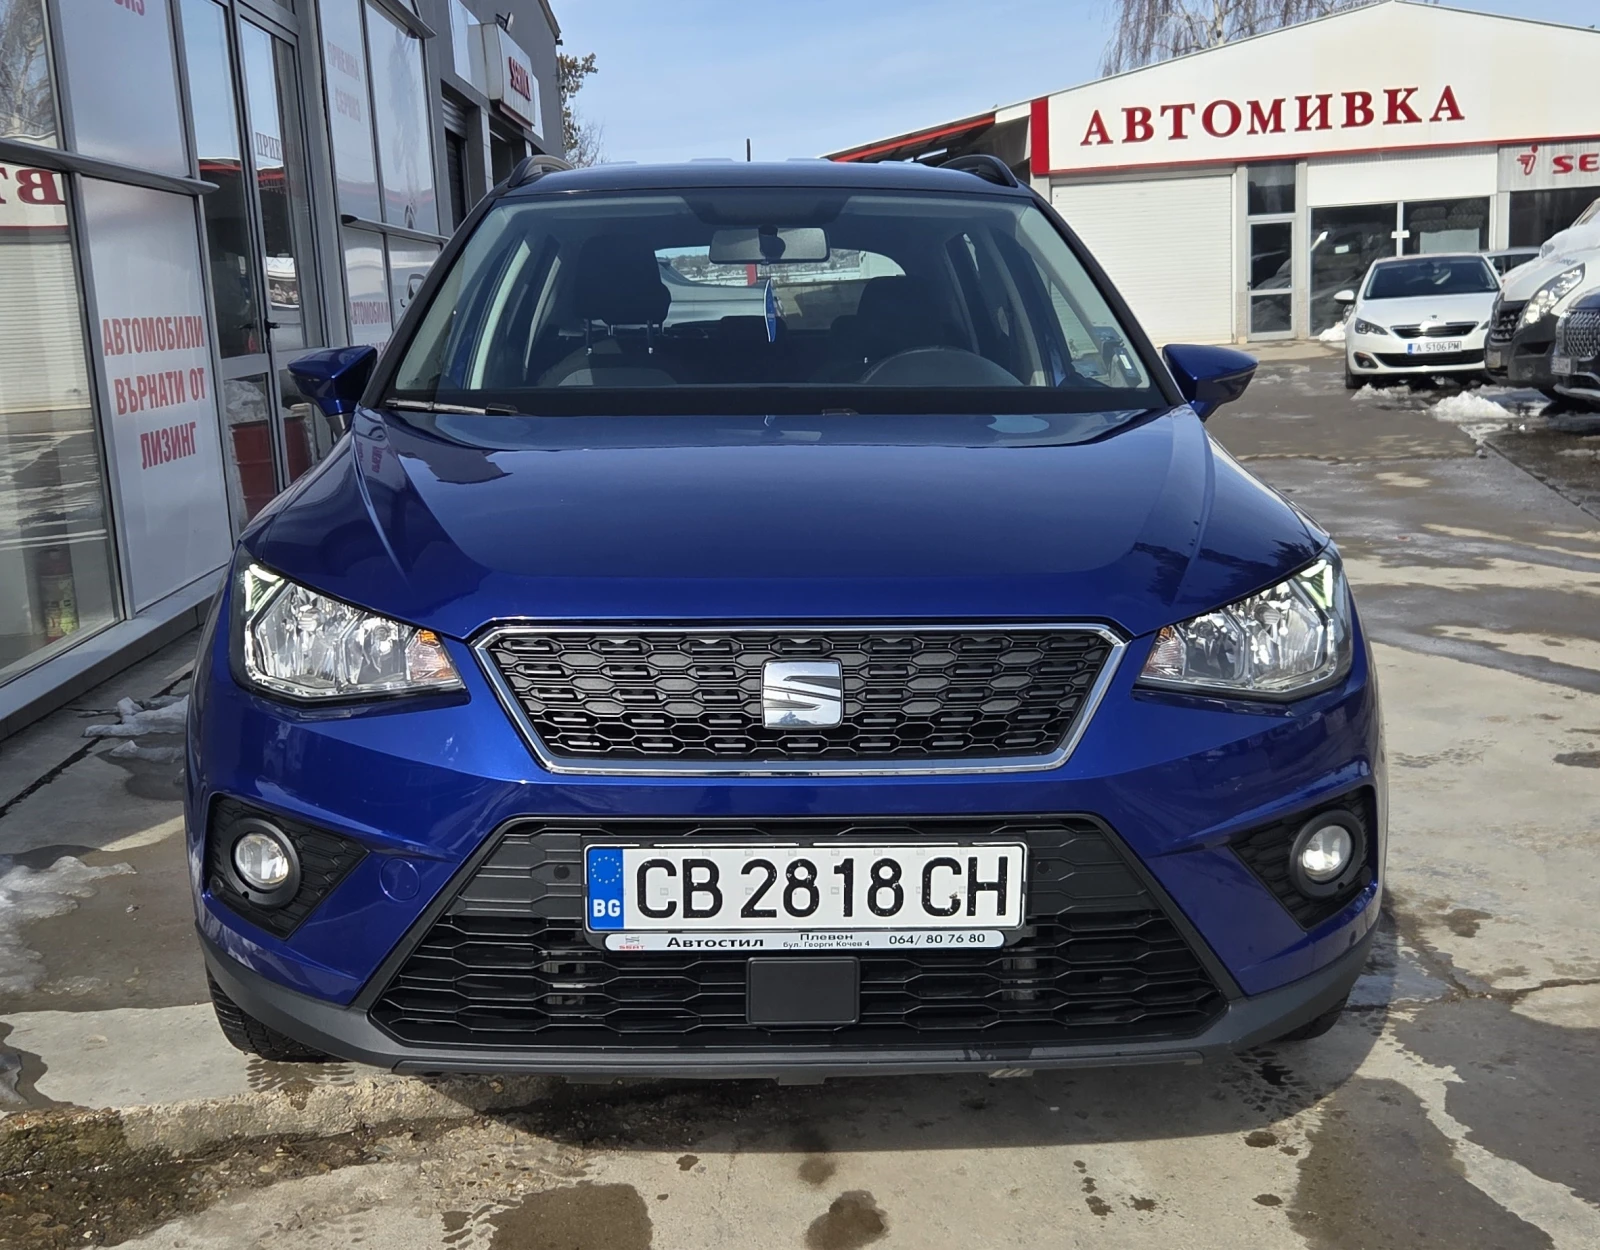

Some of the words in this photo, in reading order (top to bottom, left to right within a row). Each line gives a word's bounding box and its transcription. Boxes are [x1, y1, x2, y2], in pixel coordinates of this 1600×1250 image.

[1080, 84, 1465, 146] АВТОМИВКА
[102, 315, 205, 356] АВТОМОБИЛИ
[114, 370, 186, 416] ВЪРНАТИ
[189, 367, 206, 401] ОТ
[140, 421, 196, 470] ЛИЗИНГ
[636, 858, 723, 919] CB
[740, 857, 904, 919] 2818
[921, 856, 1008, 917] CH
[593, 899, 621, 918] BG
[666, 937, 764, 948] Автостил
[800, 933, 853, 941] Плевен
[804, 941, 833, 949] Георги
[889, 934, 921, 946] 064/
[926, 934, 943, 944] 80
[948, 933, 964, 944] 76
[968, 933, 985, 943] 80
